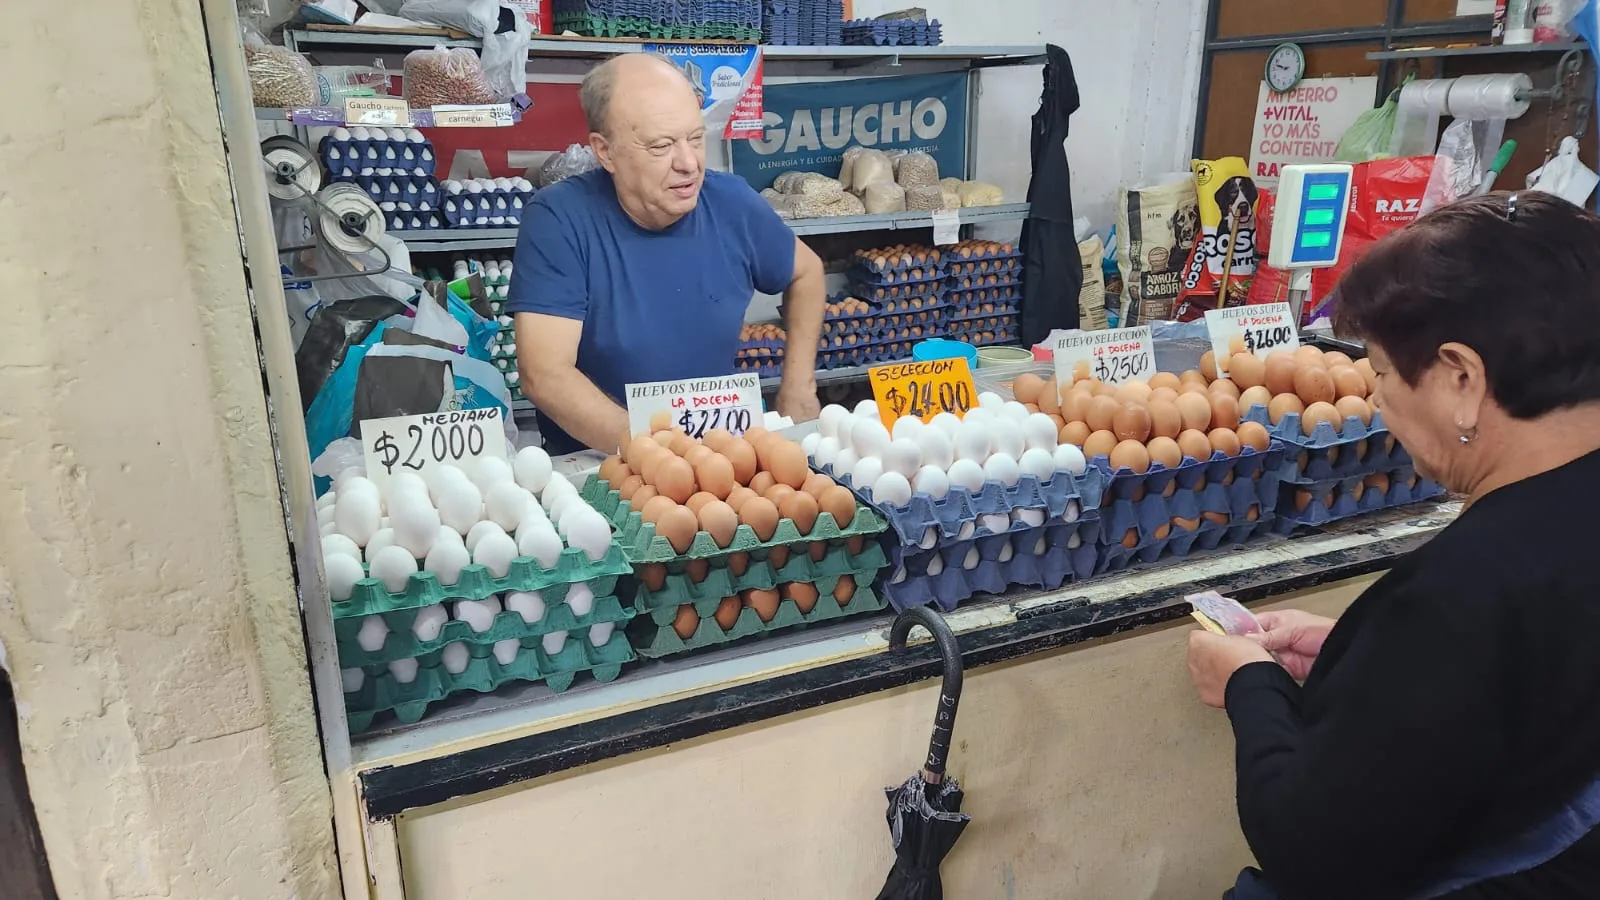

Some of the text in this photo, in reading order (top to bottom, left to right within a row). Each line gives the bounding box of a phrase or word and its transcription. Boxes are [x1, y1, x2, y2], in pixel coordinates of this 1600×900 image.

[1287, 86, 1338, 103] PERRO
[350, 101, 382, 110] Gaucho
[750, 96, 948, 155] GAUCHO
[1263, 123, 1284, 138] YO
[807, 157, 814, 165] EL
[1256, 162, 1287, 177] RA
[1202, 229, 1256, 257] ROS
[1146, 272, 1179, 284] ARROZ
[1221, 303, 1288, 319] HUEVOS SUPER
[1237, 314, 1283, 328] LA DOCENA
[1058, 328, 1149, 349] HUEVO SELECCIÓN
[1244, 326, 1291, 355] $2600
[1093, 341, 1141, 356] LA DOCENA
[631, 377, 756, 398] HUEVOS MEDIANOS
[671, 393, 740, 408] LA DOCENA
[373, 423, 484, 476] $2000
